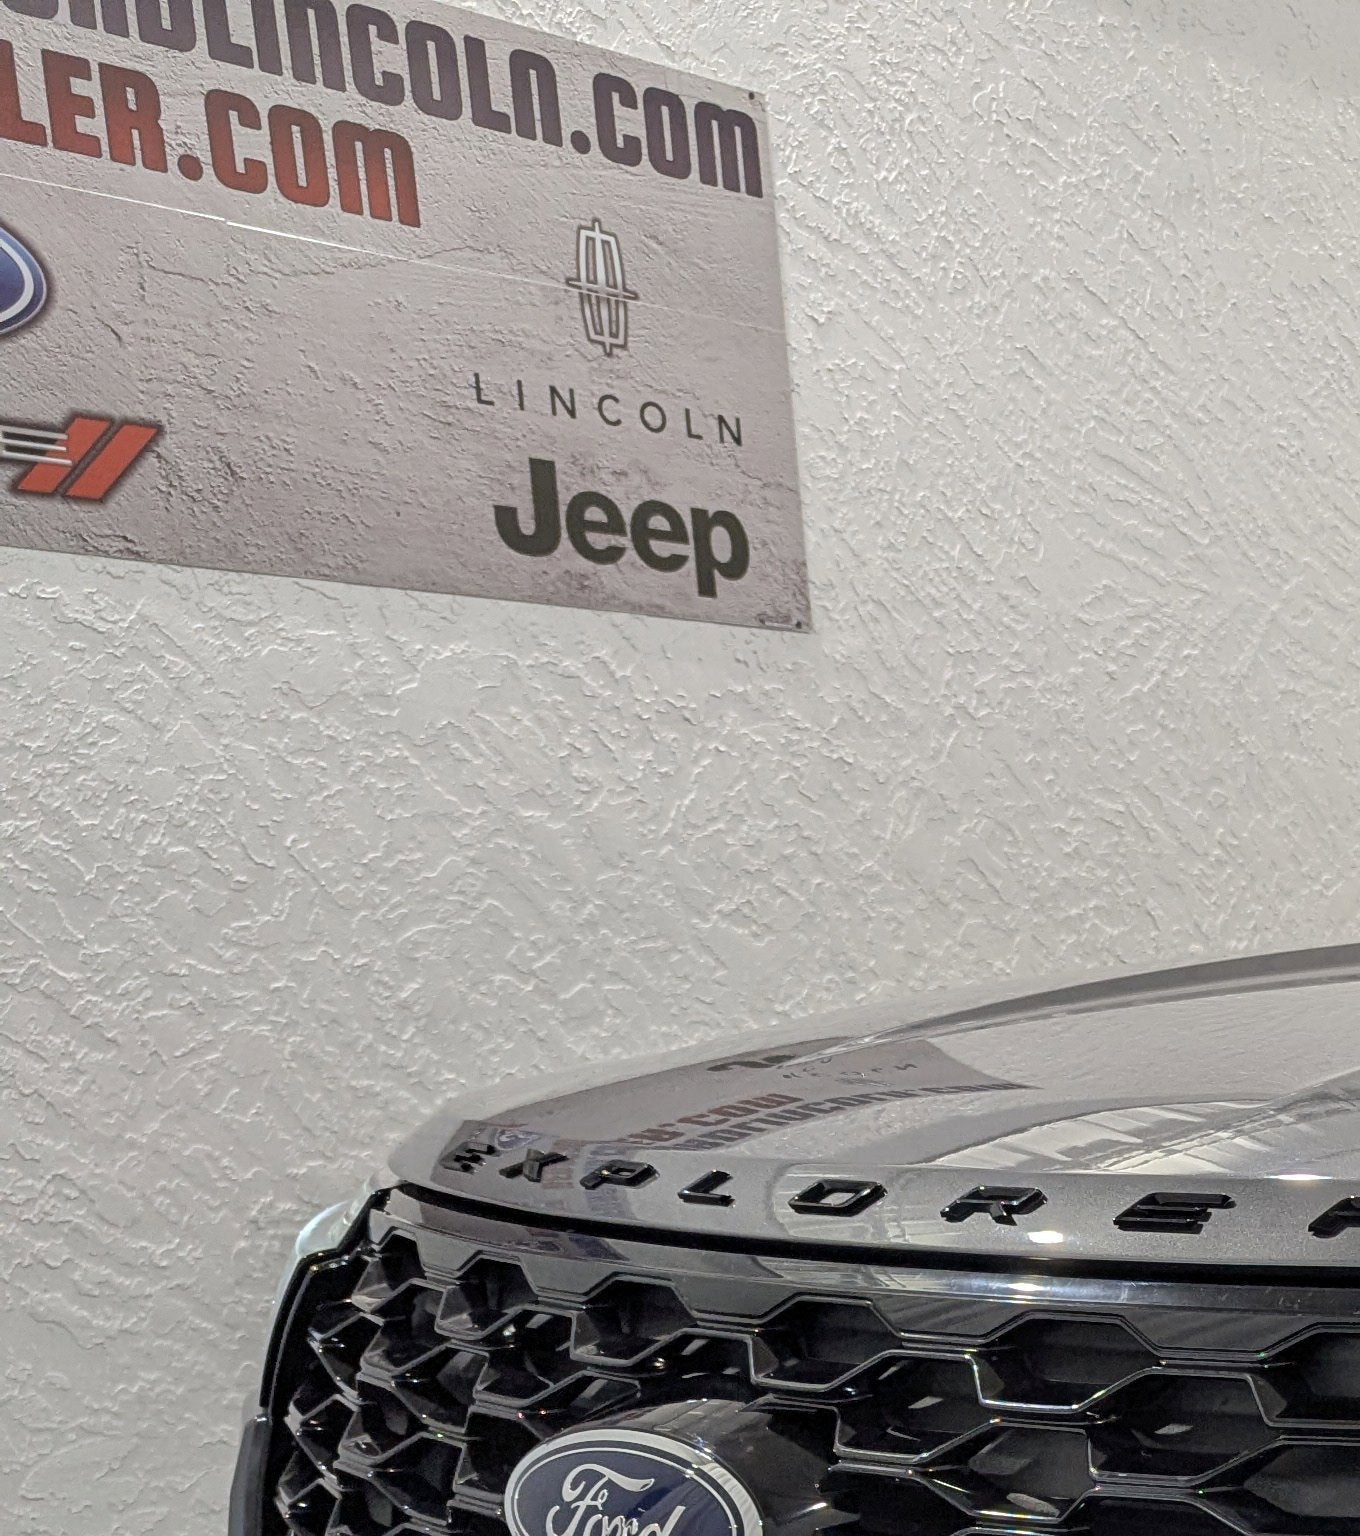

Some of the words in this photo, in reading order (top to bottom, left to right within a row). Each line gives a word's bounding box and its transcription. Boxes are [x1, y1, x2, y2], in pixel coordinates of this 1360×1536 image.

[3, 0, 763, 198] LINCOLN.COM
[473, 372, 743, 447] LINCOLN
[493, 457, 750, 599] Jeep
